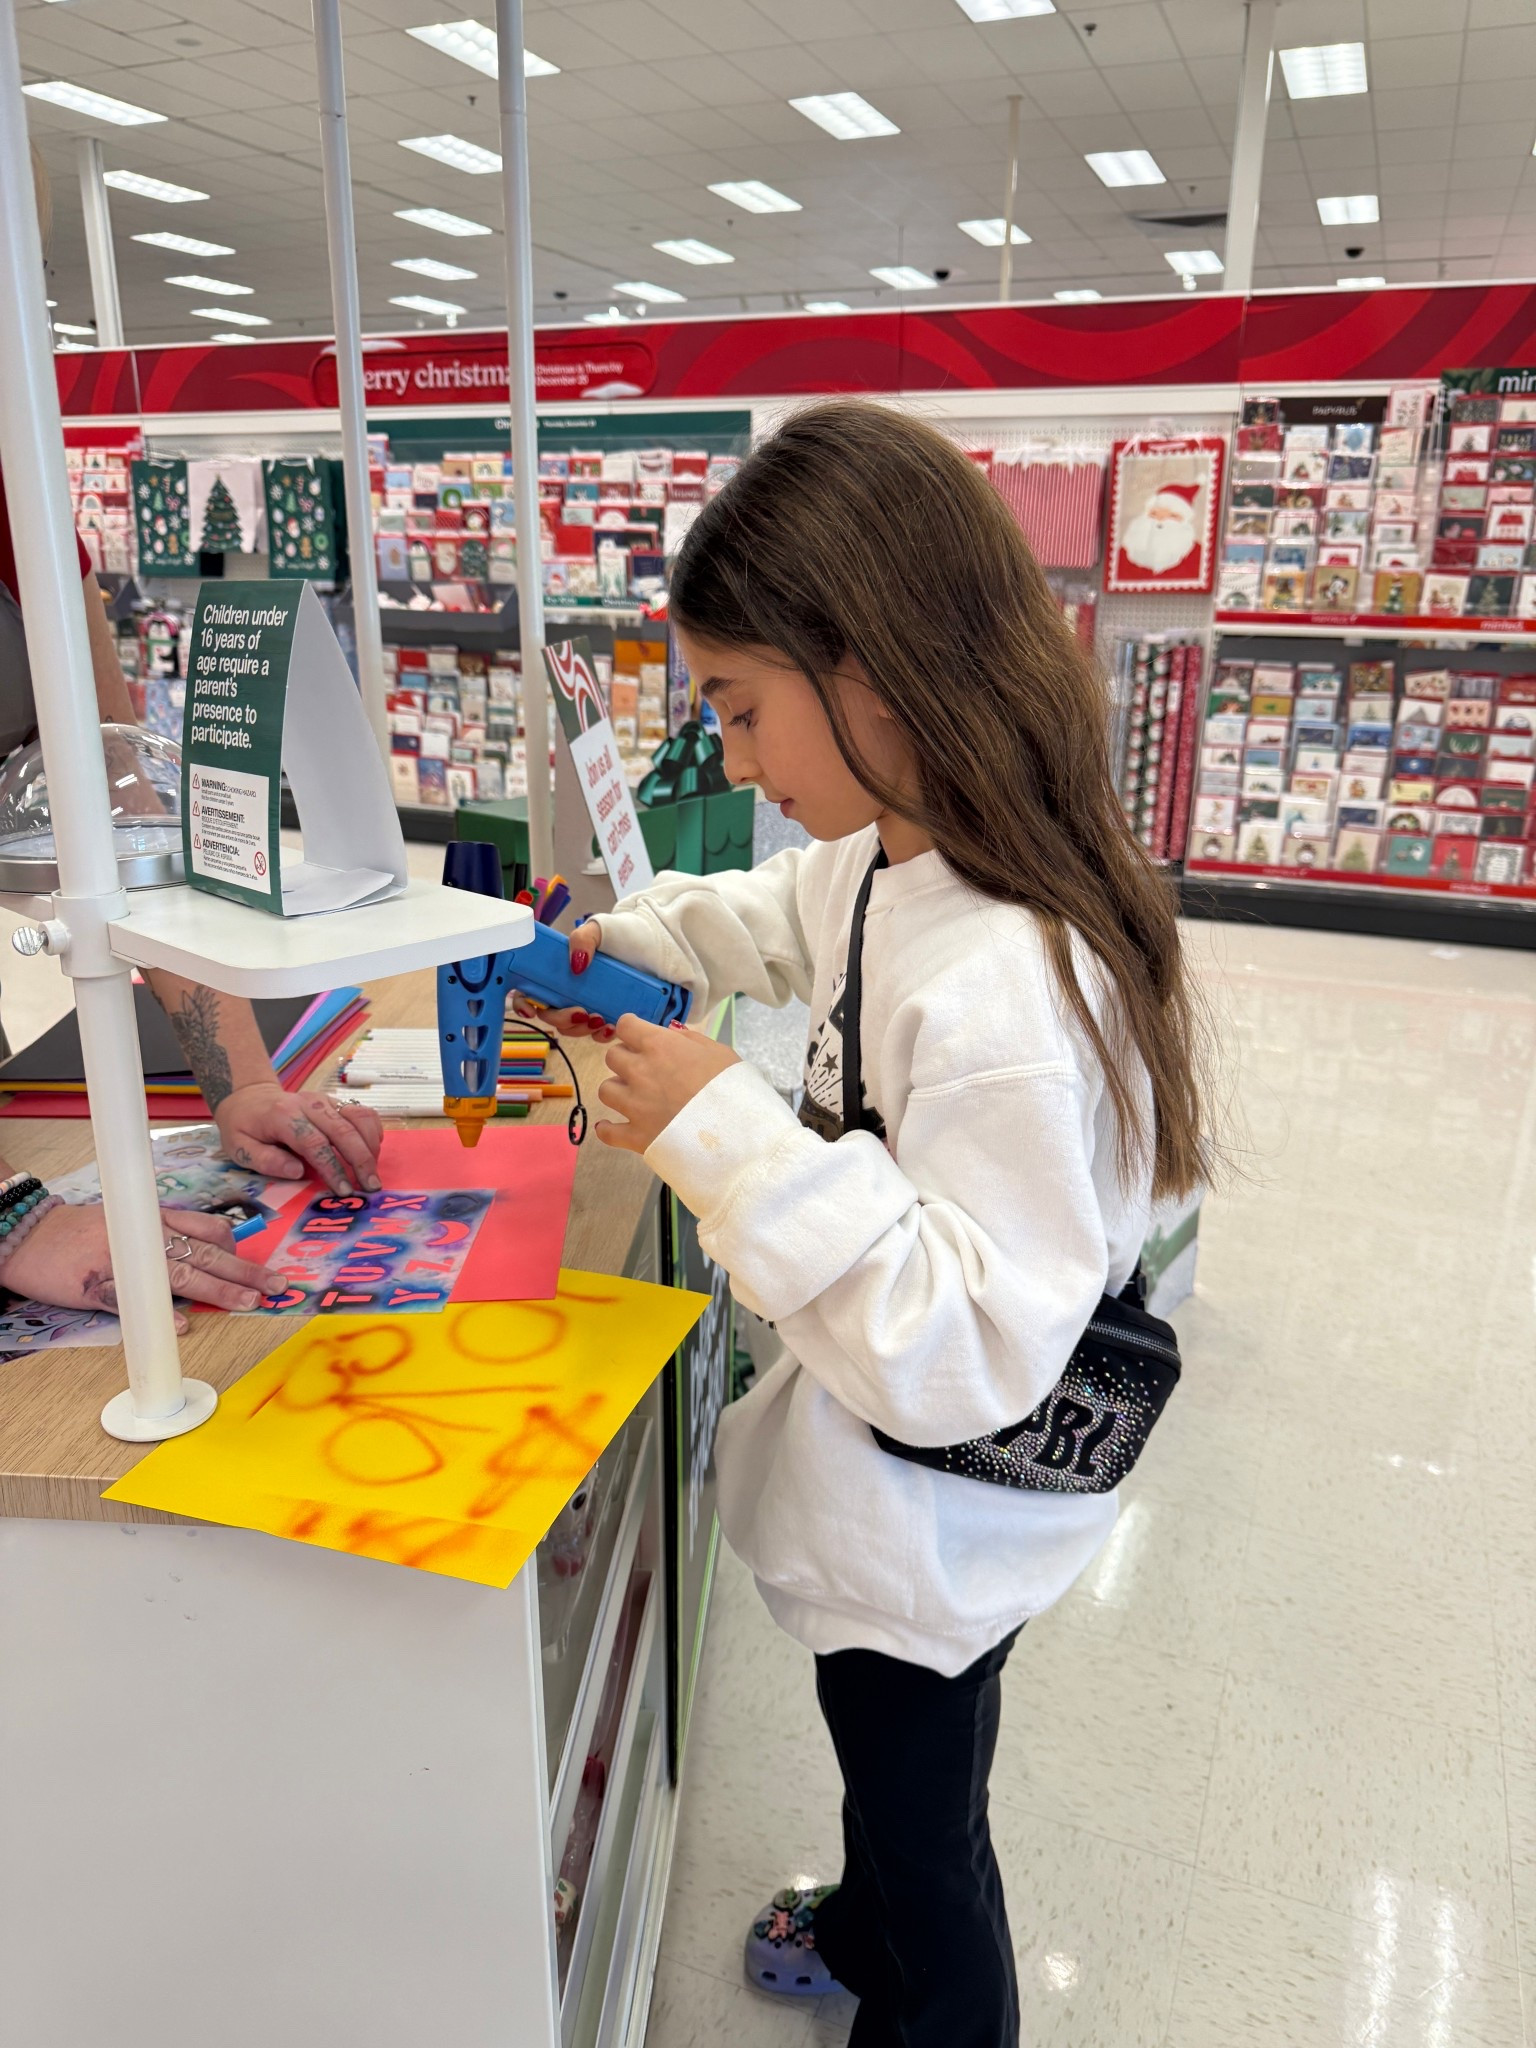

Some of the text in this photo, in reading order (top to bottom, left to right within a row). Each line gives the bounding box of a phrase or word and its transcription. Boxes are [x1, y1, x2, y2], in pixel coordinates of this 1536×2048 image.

[365, 366, 410, 396] erry
[203, 604, 289, 627] Children under
[201, 627, 262, 653] 16 years of
[196, 653, 270, 678] age require a
[194, 676, 238, 698] parent's
[192, 702, 258, 725] presence to
[191, 723, 252, 750] participate.
[596, 789, 615, 823] season
[618, 852, 635, 890] events
